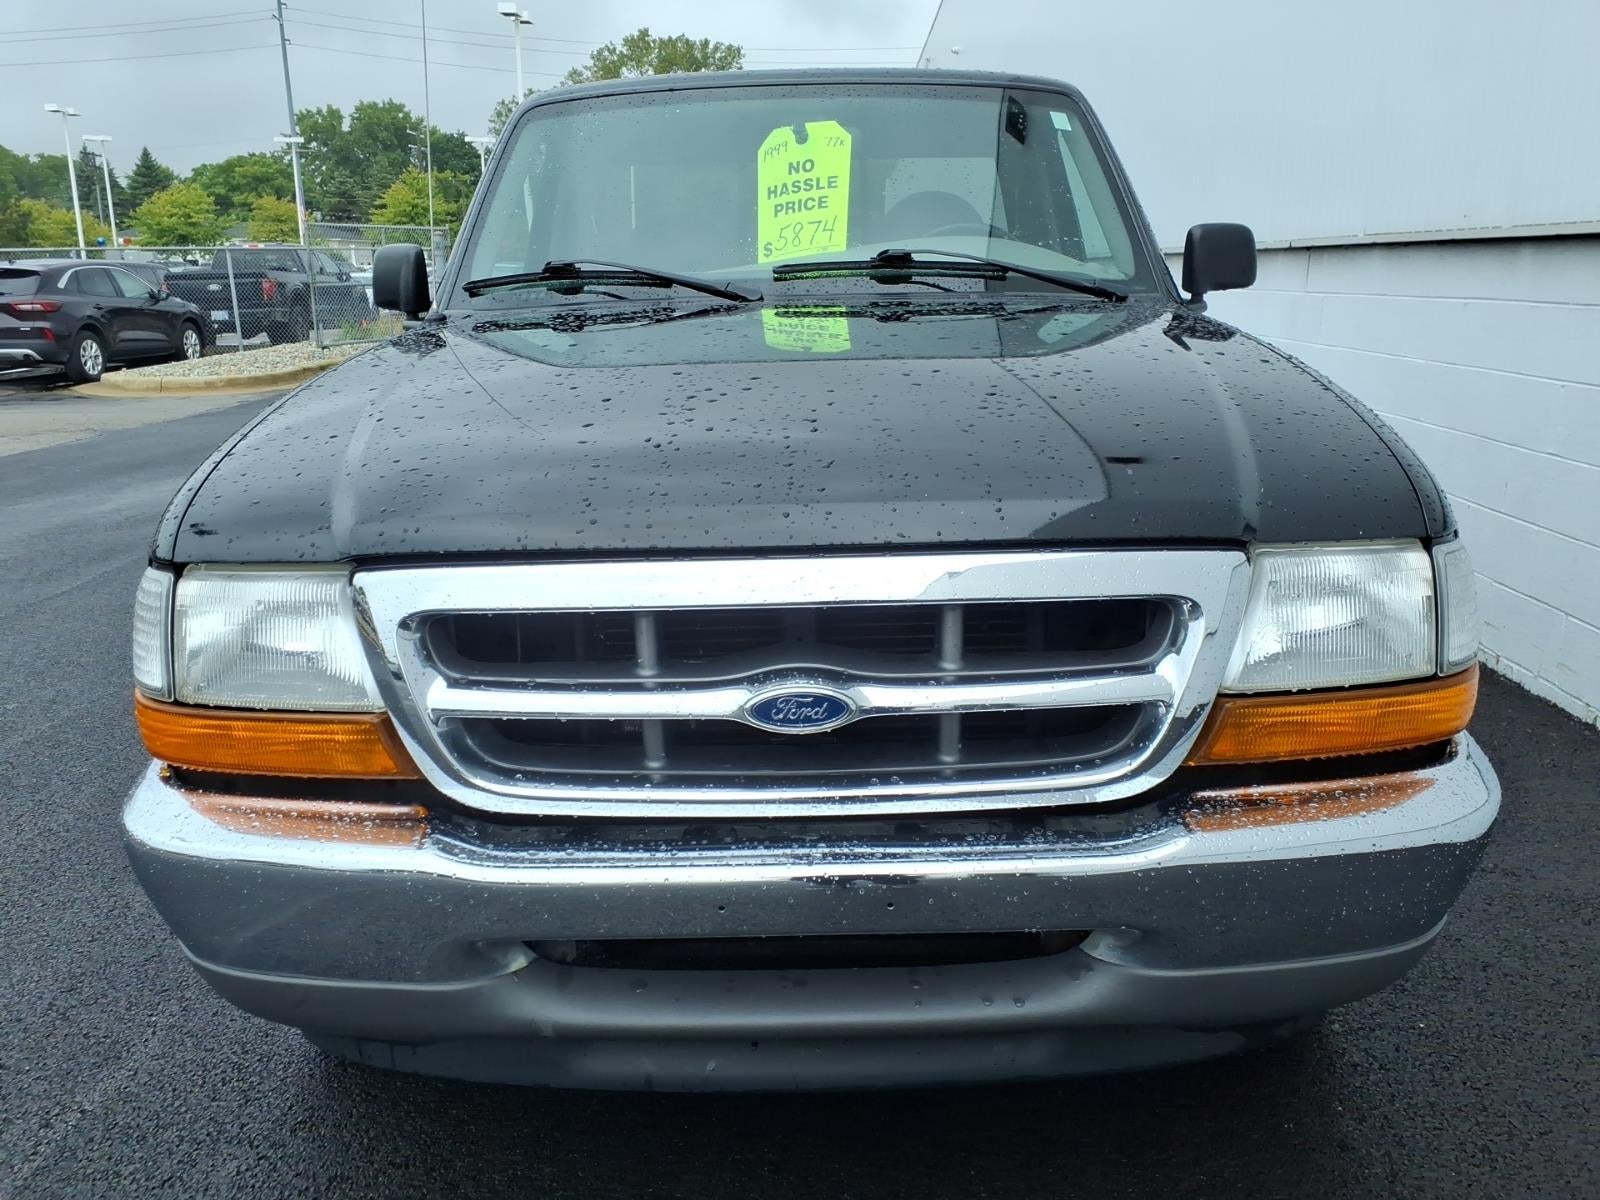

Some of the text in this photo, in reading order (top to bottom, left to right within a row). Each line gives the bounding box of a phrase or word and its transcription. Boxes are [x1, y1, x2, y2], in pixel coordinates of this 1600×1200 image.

[763, 140, 788, 163] 1999
[788, 158, 815, 175] NO
[767, 175, 839, 201] HASSLE
[774, 195, 829, 218] PRICE
[771, 697, 828, 720] Ford
